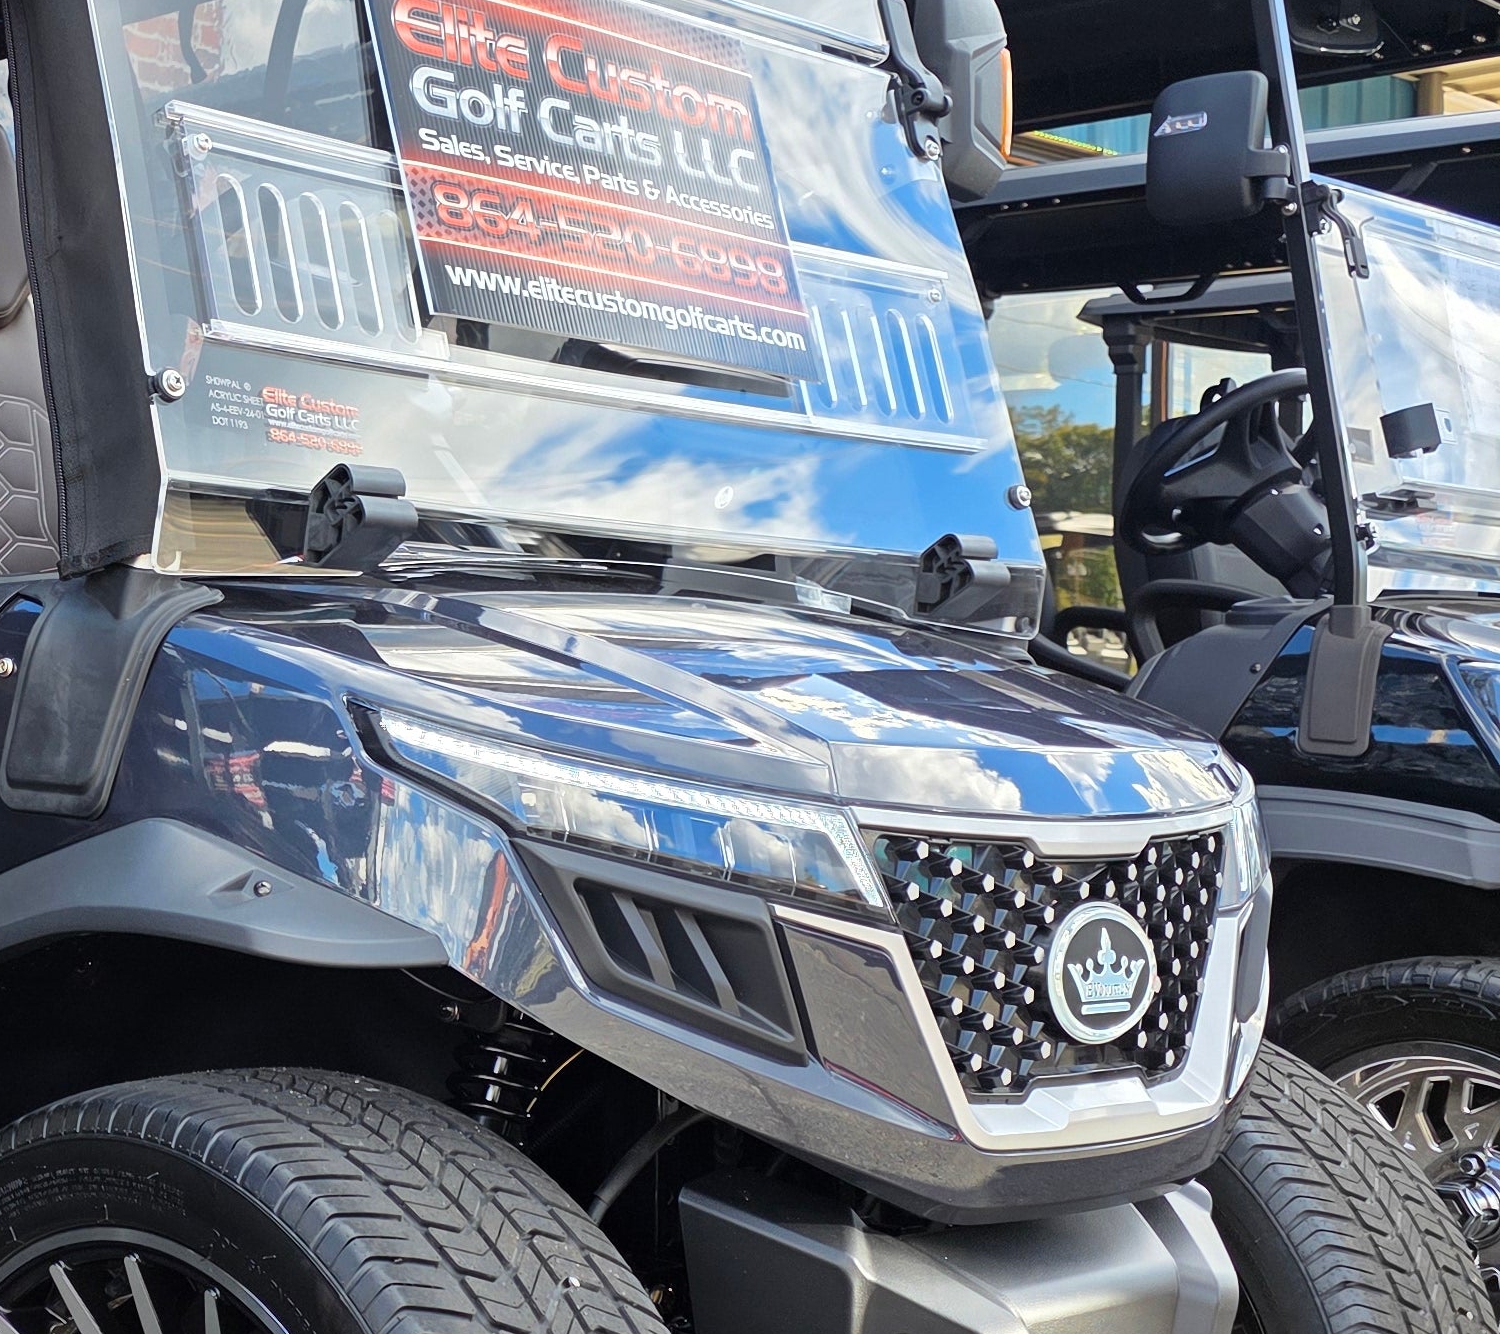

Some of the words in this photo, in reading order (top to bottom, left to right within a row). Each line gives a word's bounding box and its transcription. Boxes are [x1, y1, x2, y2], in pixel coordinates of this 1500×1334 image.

[409, 66, 529, 135] Golf
[538, 96, 663, 166] Carts
[673, 130, 760, 194] LLC
[543, 32, 753, 143] Custom
[418, 127, 491, 165] Sales,
[493, 144, 580, 185] Service,
[582, 164, 640, 197] Parts
[642, 179, 661, 201] &
[665, 184, 775, 230] Accessories
[431, 180, 788, 296] 864-520-6898
[445, 264, 807, 351] www.elitecustomgolfcarts.com
[209, 389, 242, 403] ACRYLIC
[211, 415, 229, 427] DOT
[262, 386, 297, 407] Elite
[300, 392, 361, 418] Custom
[265, 403, 296, 421] Golf
[298, 409, 332, 427] Carts
[334, 415, 361, 430] LLC
